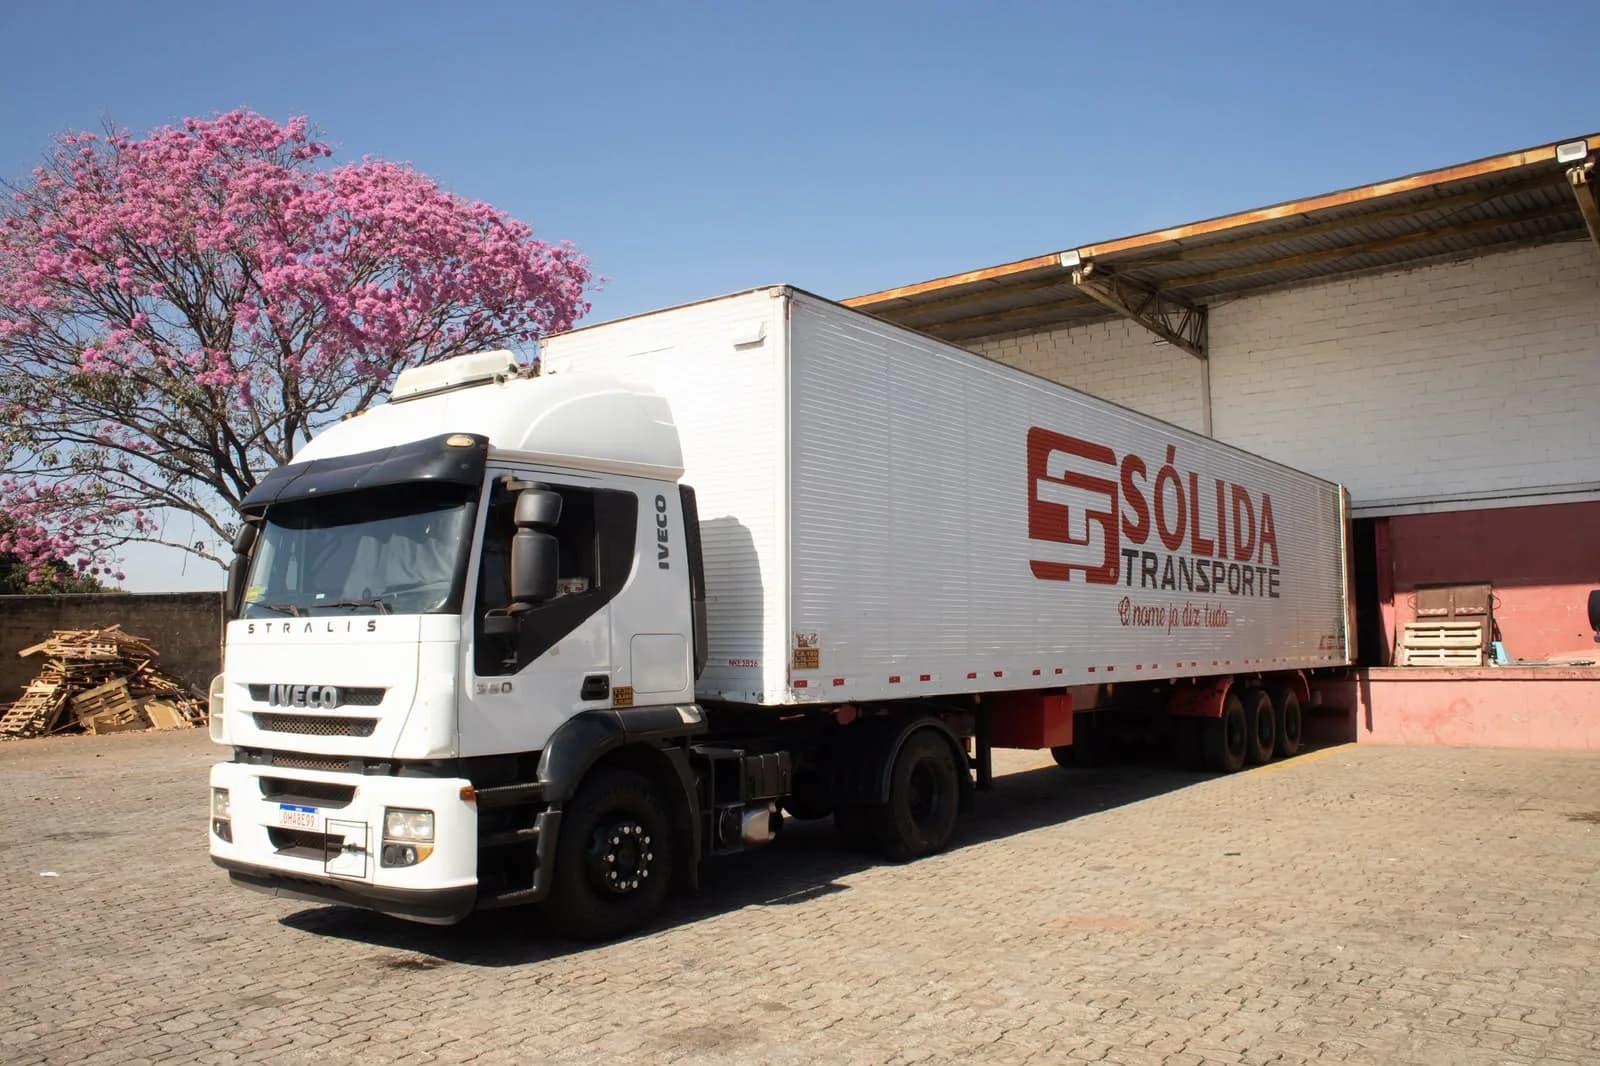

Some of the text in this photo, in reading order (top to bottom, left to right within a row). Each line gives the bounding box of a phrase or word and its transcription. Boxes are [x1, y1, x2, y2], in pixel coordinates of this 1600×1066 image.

[1120, 444, 1280, 566] SÓLIDA
[655, 494, 669, 570] IVECO
[1121, 548, 1280, 598] TRANSPORTE
[248, 620, 376, 634] STRALIS
[1133, 606, 1166, 626] nome
[1182, 601, 1200, 627] diz
[1205, 602, 1228, 627] tudo
[268, 684, 339, 709] IVECO
